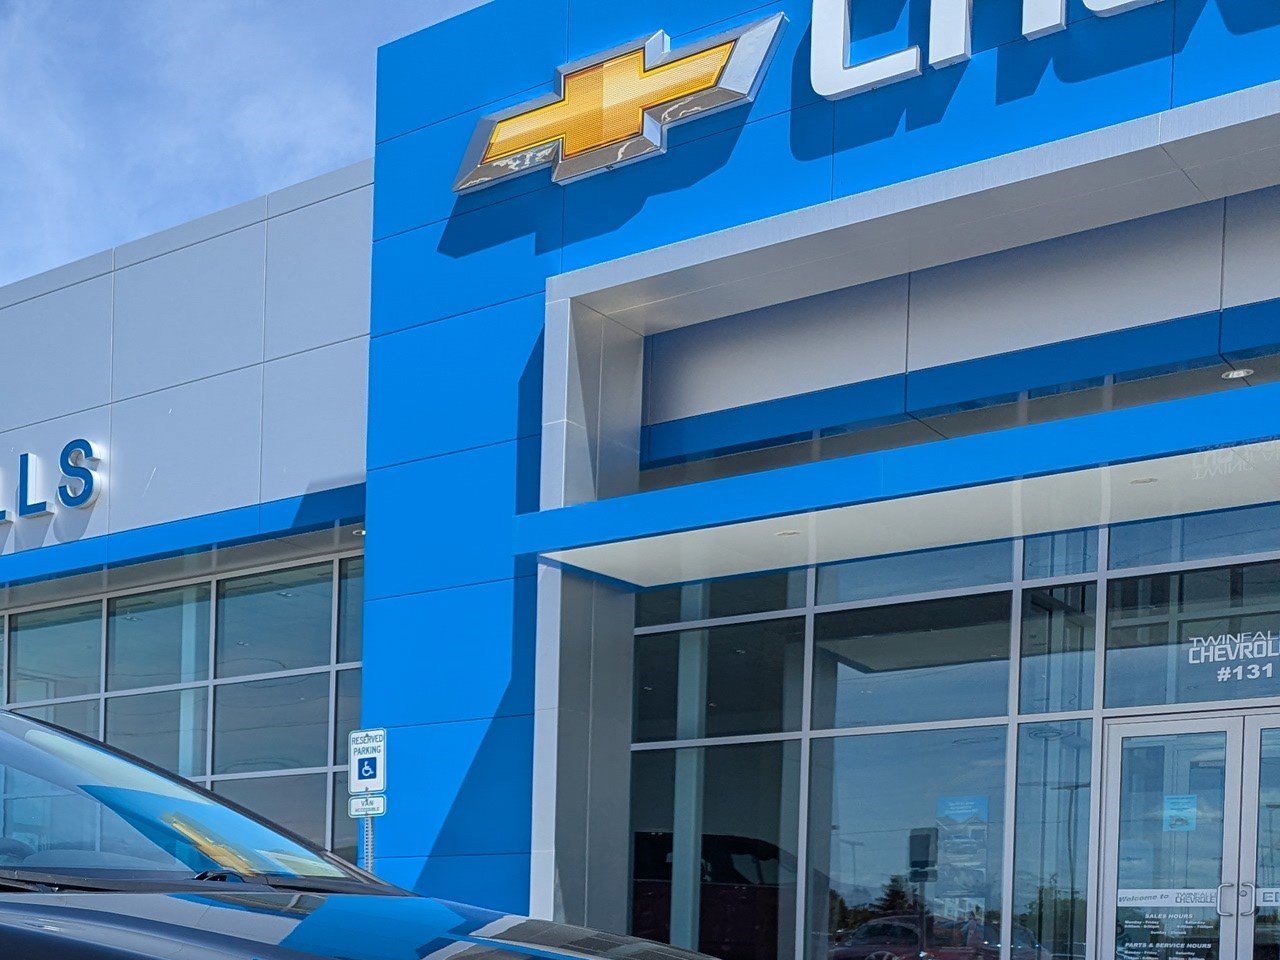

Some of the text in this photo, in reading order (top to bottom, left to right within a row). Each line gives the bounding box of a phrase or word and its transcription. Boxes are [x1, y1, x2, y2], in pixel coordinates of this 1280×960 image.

[1188, 630, 1280, 648] TWINFAL
[1188, 640, 1280, 664] CHEVROL
[1217, 663, 1273, 682] #131
[352, 734, 384, 746] RESERVED
[353, 746, 381, 756] PARKING
[1119, 895, 1157, 903] Welcome
